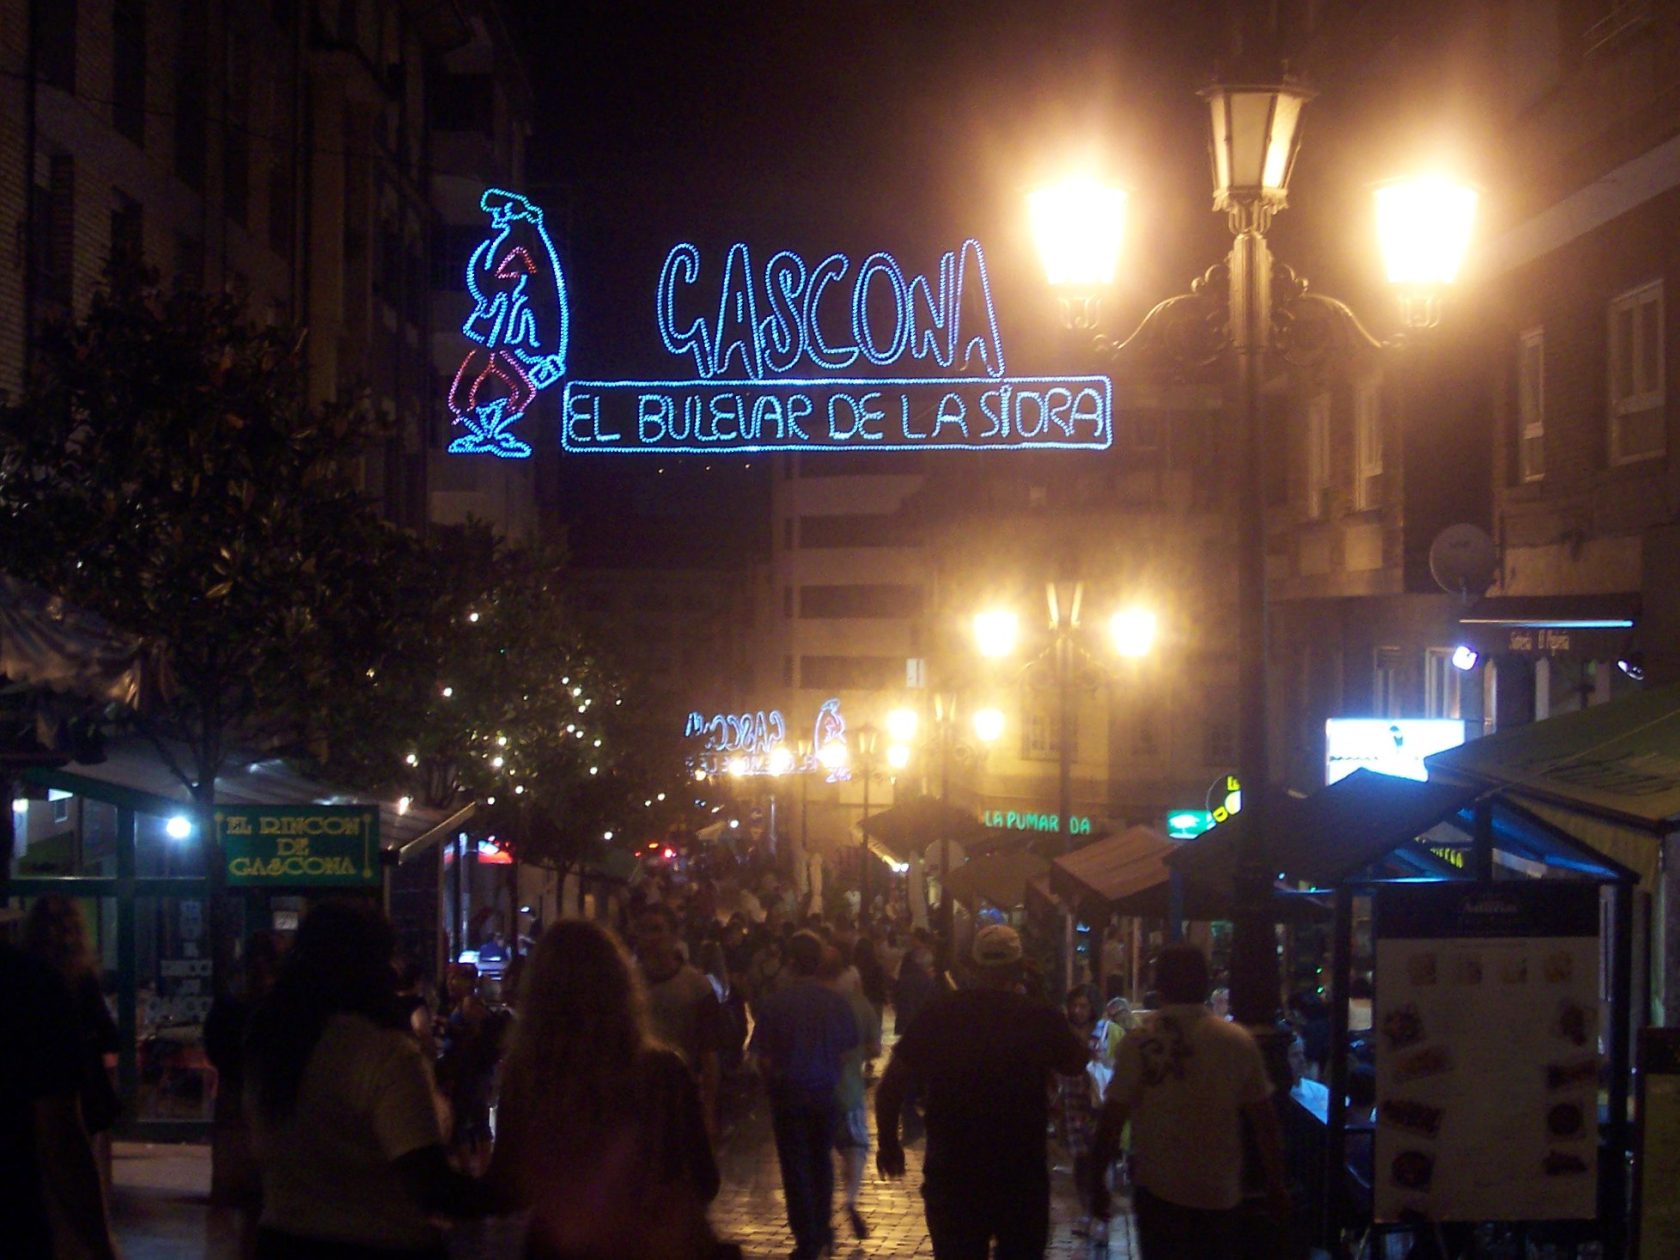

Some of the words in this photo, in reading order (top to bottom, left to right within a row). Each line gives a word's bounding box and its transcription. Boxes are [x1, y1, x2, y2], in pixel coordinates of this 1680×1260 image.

[656, 238, 1005, 380] GASCONA
[567, 394, 621, 442] EL
[638, 393, 814, 443] BULEVAR
[827, 392, 886, 441] DE
[901, 392, 969, 438] LA
[226, 816, 252, 834] EL
[259, 816, 360, 834] RINCON
[984, 810, 1004, 827] LA
[1006, 810, 1091, 835] PUMARDA
[276, 838, 309, 856] DE
[228, 857, 356, 875] GASCONA
